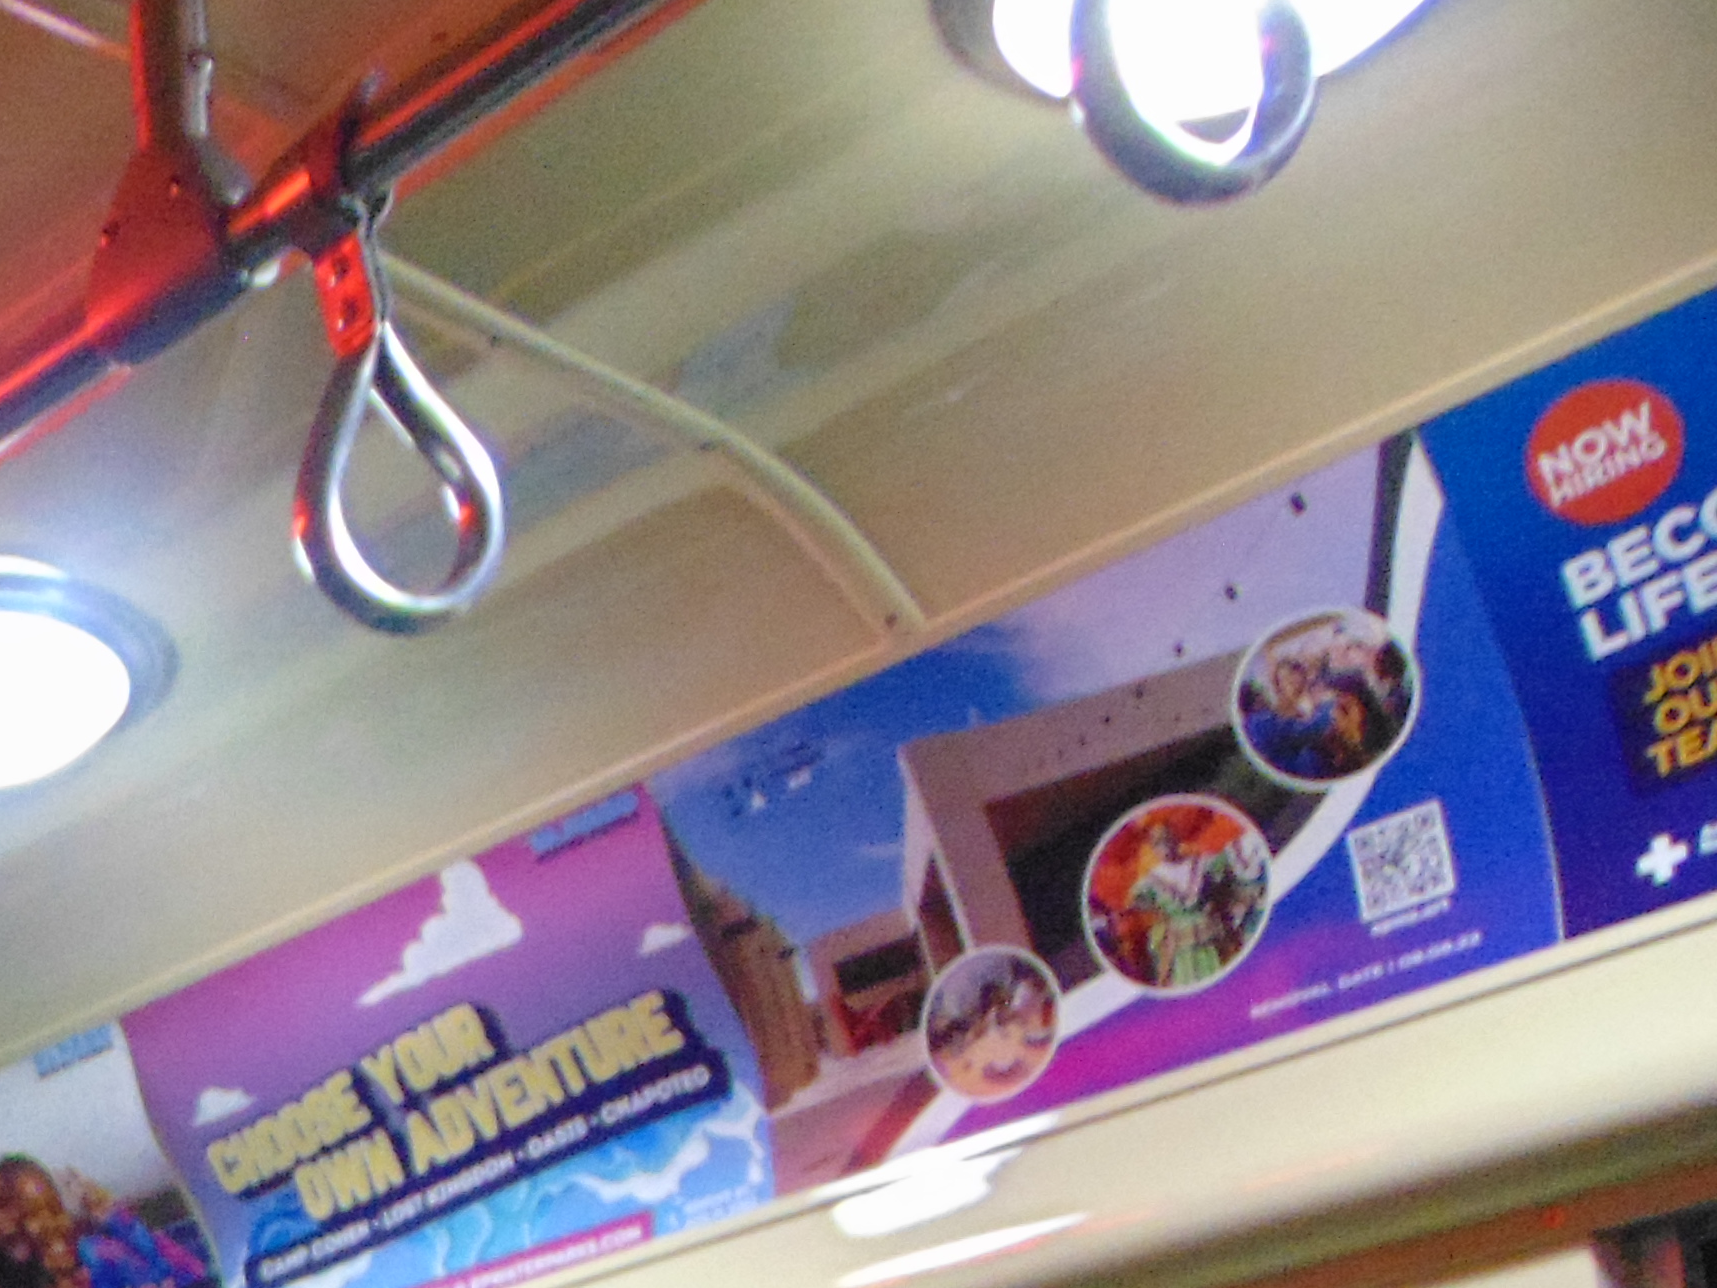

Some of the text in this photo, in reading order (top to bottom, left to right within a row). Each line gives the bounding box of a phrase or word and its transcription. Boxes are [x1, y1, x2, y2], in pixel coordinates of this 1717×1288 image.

[1538, 400, 1651, 490] NOW
[1550, 431, 1667, 507] HIRING
[207, 1003, 495, 1195] CHOOSE YOUR
[294, 991, 686, 1220] OWN ADVENTURE
